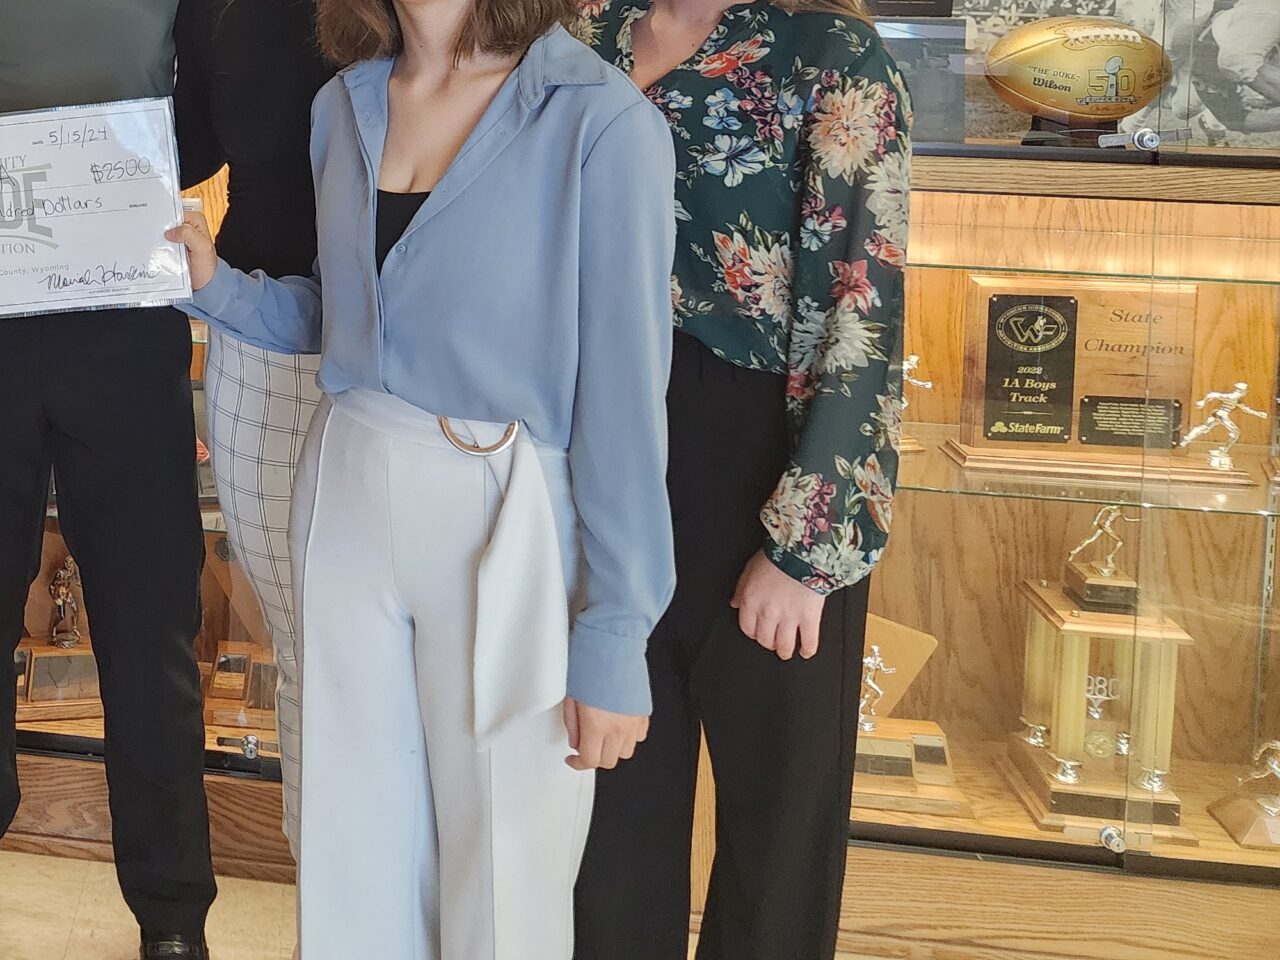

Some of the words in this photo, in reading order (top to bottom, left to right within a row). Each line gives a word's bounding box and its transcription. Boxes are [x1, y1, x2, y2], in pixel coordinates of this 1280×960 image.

[1033, 76, 1072, 93] Wilson
[1087, 68, 1136, 98] 50
[49, 122, 107, 150] 5/15/24
[90, 156, 150, 184] $2500
[42, 195, 103, 216] Dollars
[31, 263, 70, 276] Wyoming
[1109, 308, 1163, 324] State
[1084, 338, 1184, 357] Champion
[1017, 366, 1043, 375] 2022
[1002, 378, 1020, 388] 1A
[1024, 378, 1056, 391] Boys
[1010, 392, 1048, 403] Track
[1008, 422, 1064, 435] StateFarm
